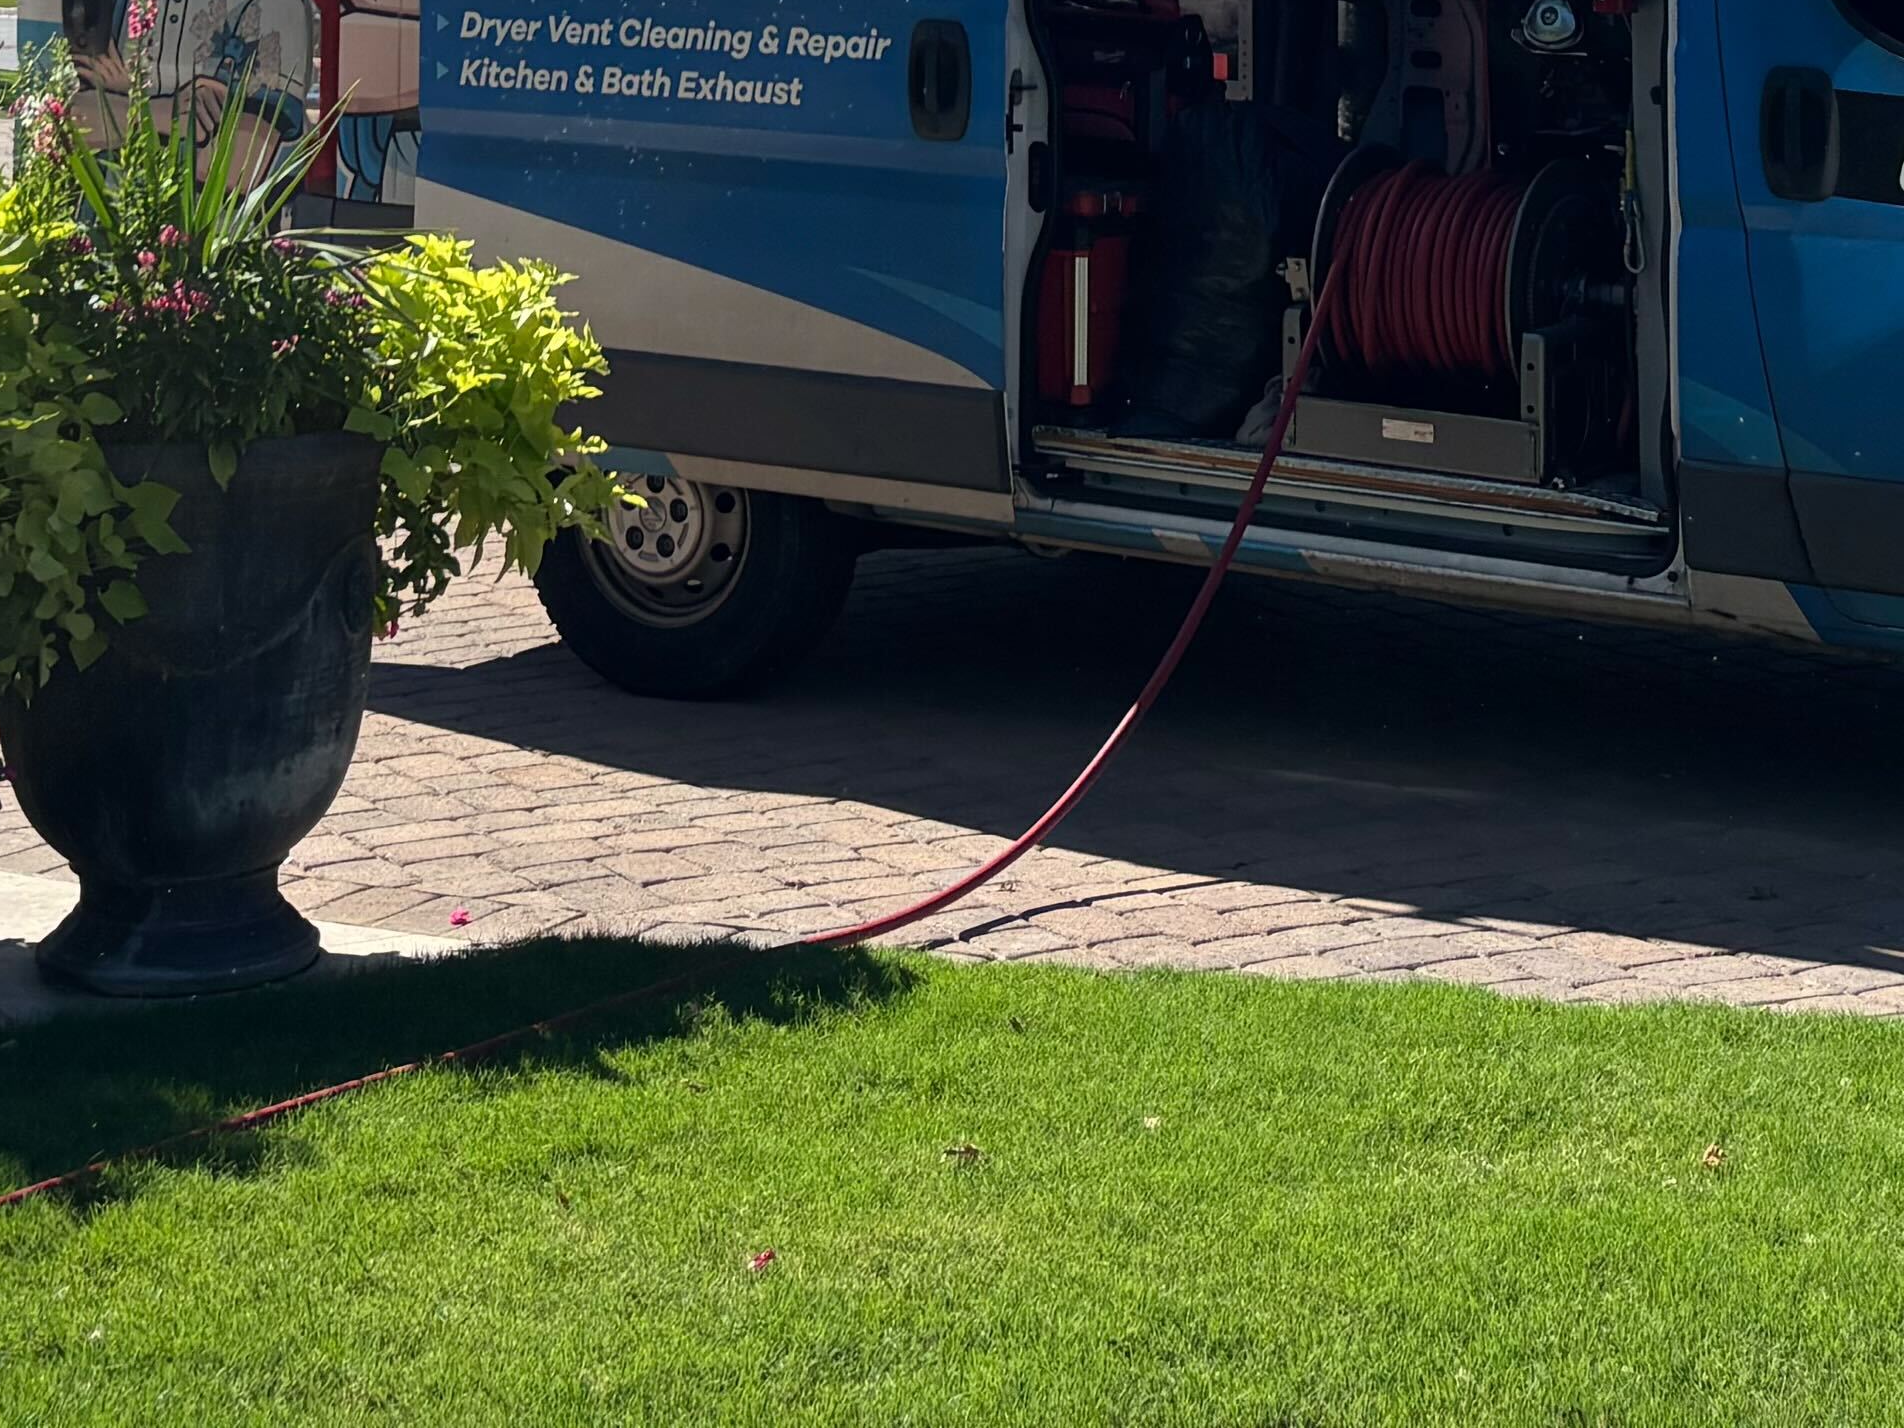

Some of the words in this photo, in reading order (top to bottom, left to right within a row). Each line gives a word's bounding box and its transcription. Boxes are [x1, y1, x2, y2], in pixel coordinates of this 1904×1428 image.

[459, 11, 542, 46] Dryer
[548, 15, 614, 45] Vent
[619, 17, 753, 59] Cleaning
[758, 24, 780, 54] &
[786, 27, 892, 64] Repair
[459, 57, 569, 92] Kitchen
[574, 64, 594, 93] &
[601, 66, 671, 98] Bath
[677, 70, 803, 106] Exhaust
